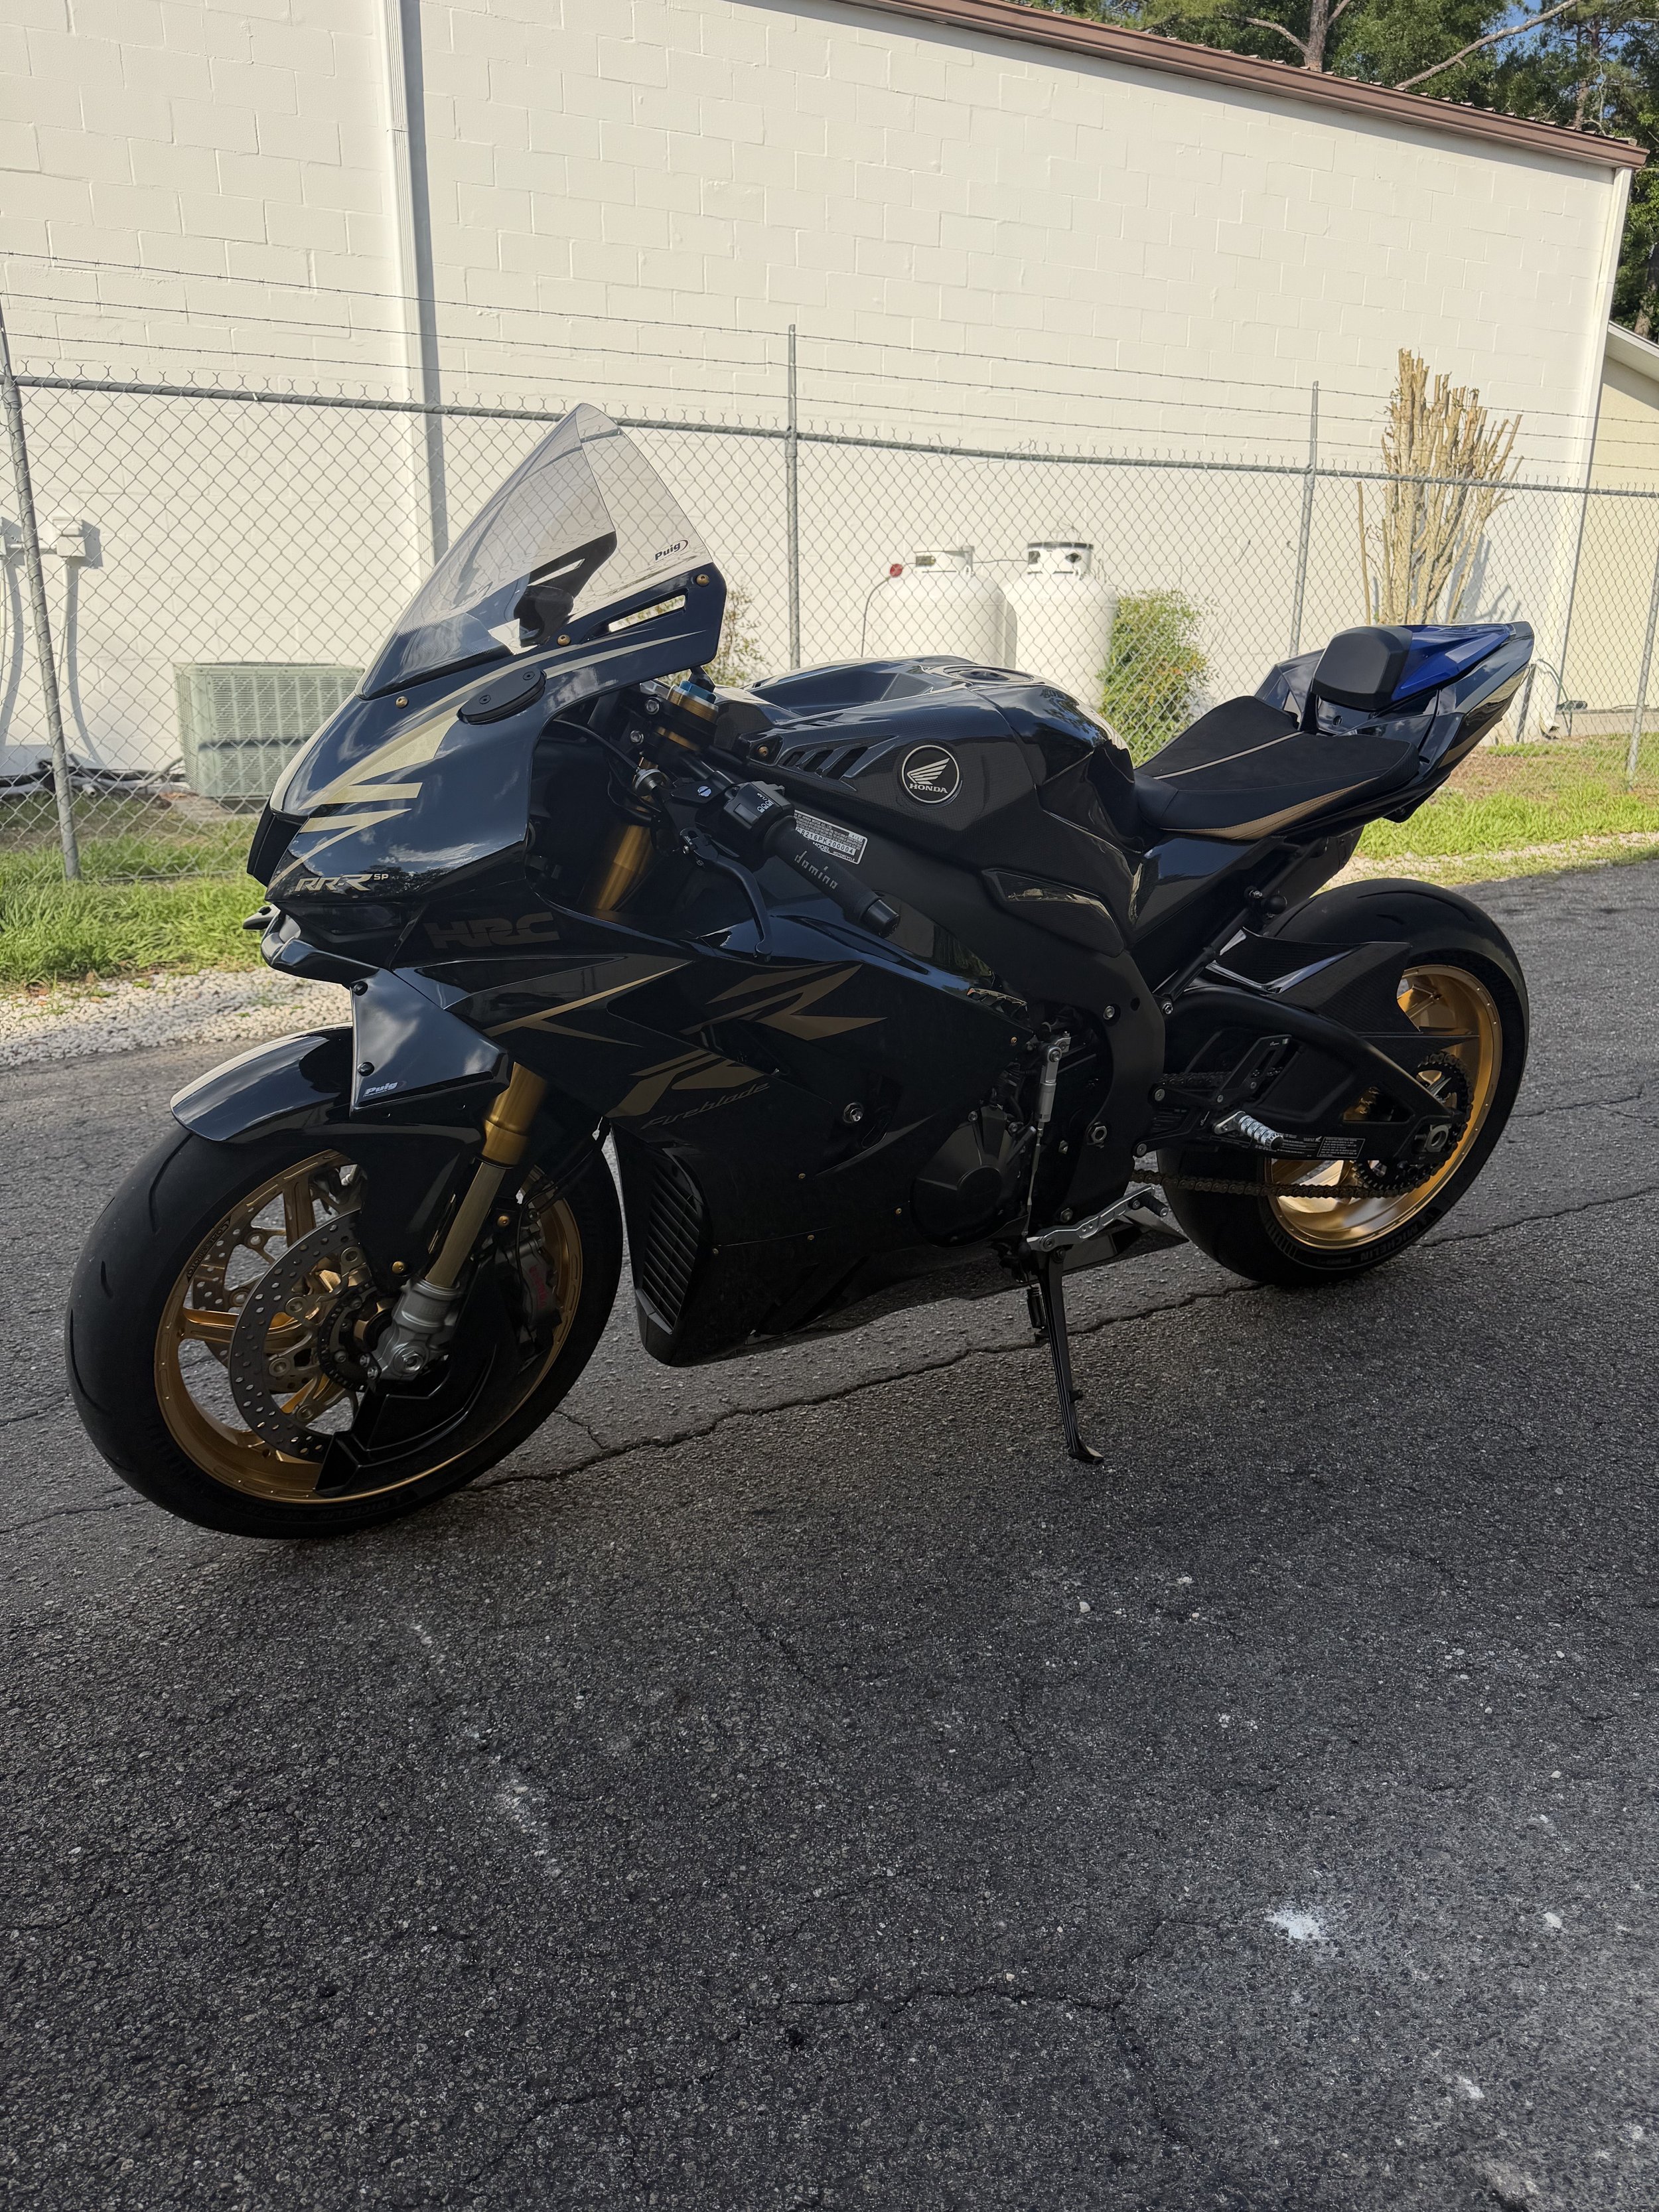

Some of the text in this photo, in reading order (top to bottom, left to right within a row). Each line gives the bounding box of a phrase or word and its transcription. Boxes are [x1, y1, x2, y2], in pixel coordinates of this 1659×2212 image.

[655, 542, 681, 561] Puig
[908, 783, 948, 794] HONDA
[794, 849, 839, 890] domino
[422, 911, 561, 949] HRC
[364, 1082, 398, 1096] Puig
[640, 1082, 770, 1130] Fireblade
[1359, 1223, 1419, 1263] MICHELIN
